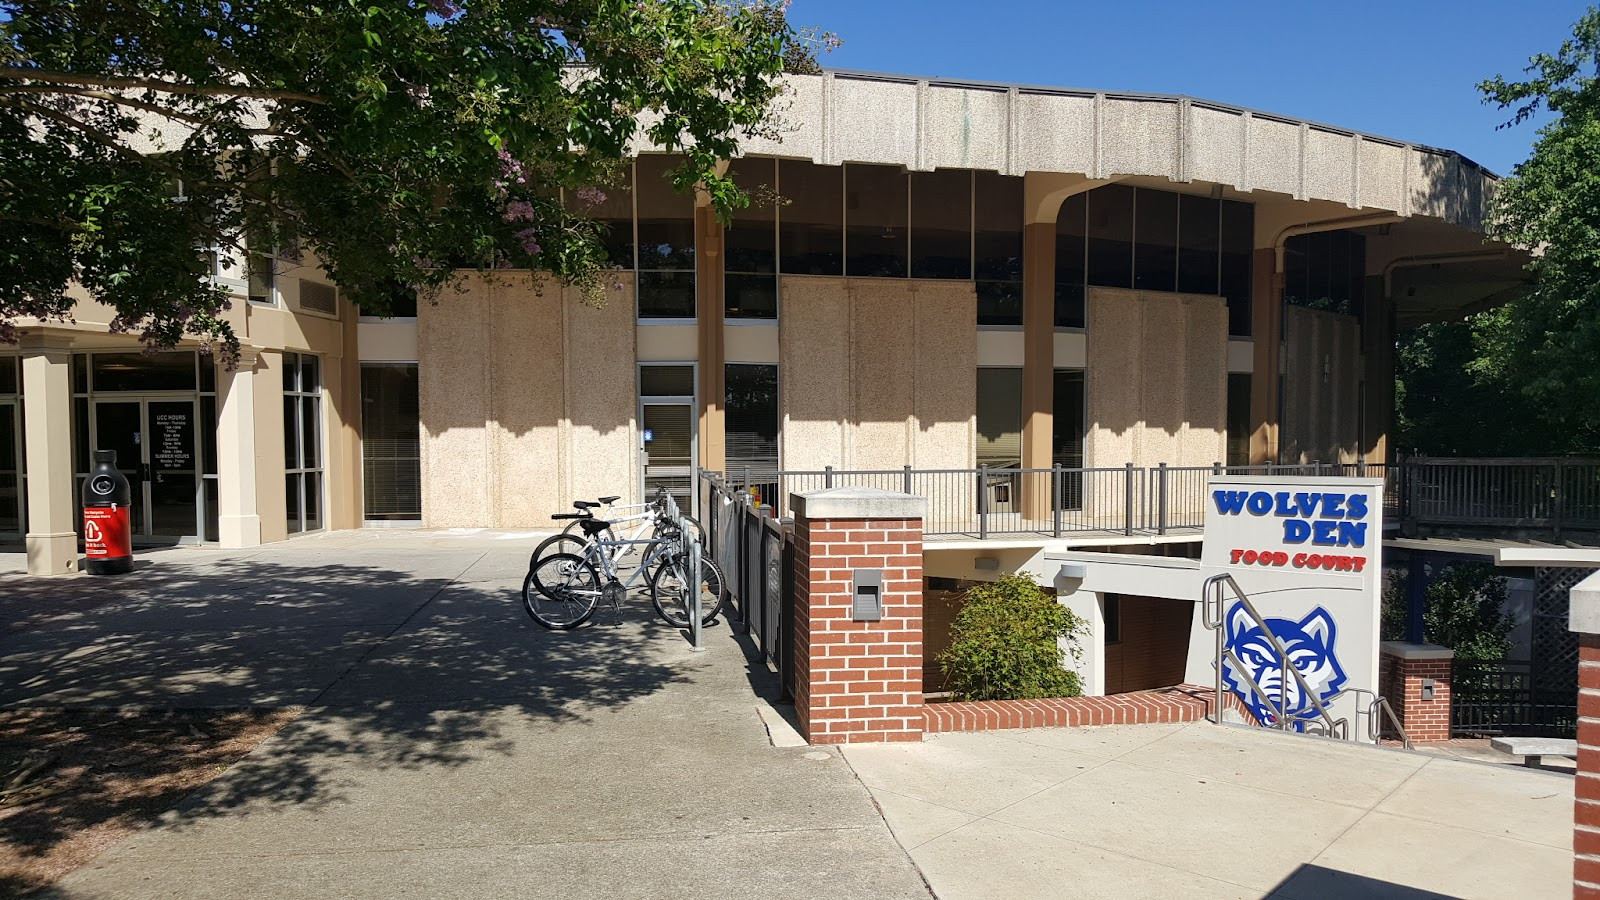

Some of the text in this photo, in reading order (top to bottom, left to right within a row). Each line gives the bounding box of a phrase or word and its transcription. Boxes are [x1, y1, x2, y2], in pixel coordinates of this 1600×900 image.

[1212, 490, 1368, 521] WOLVES
[1282, 519, 1367, 548] DEN
[1230, 549, 1366, 573] FOOD COURT
